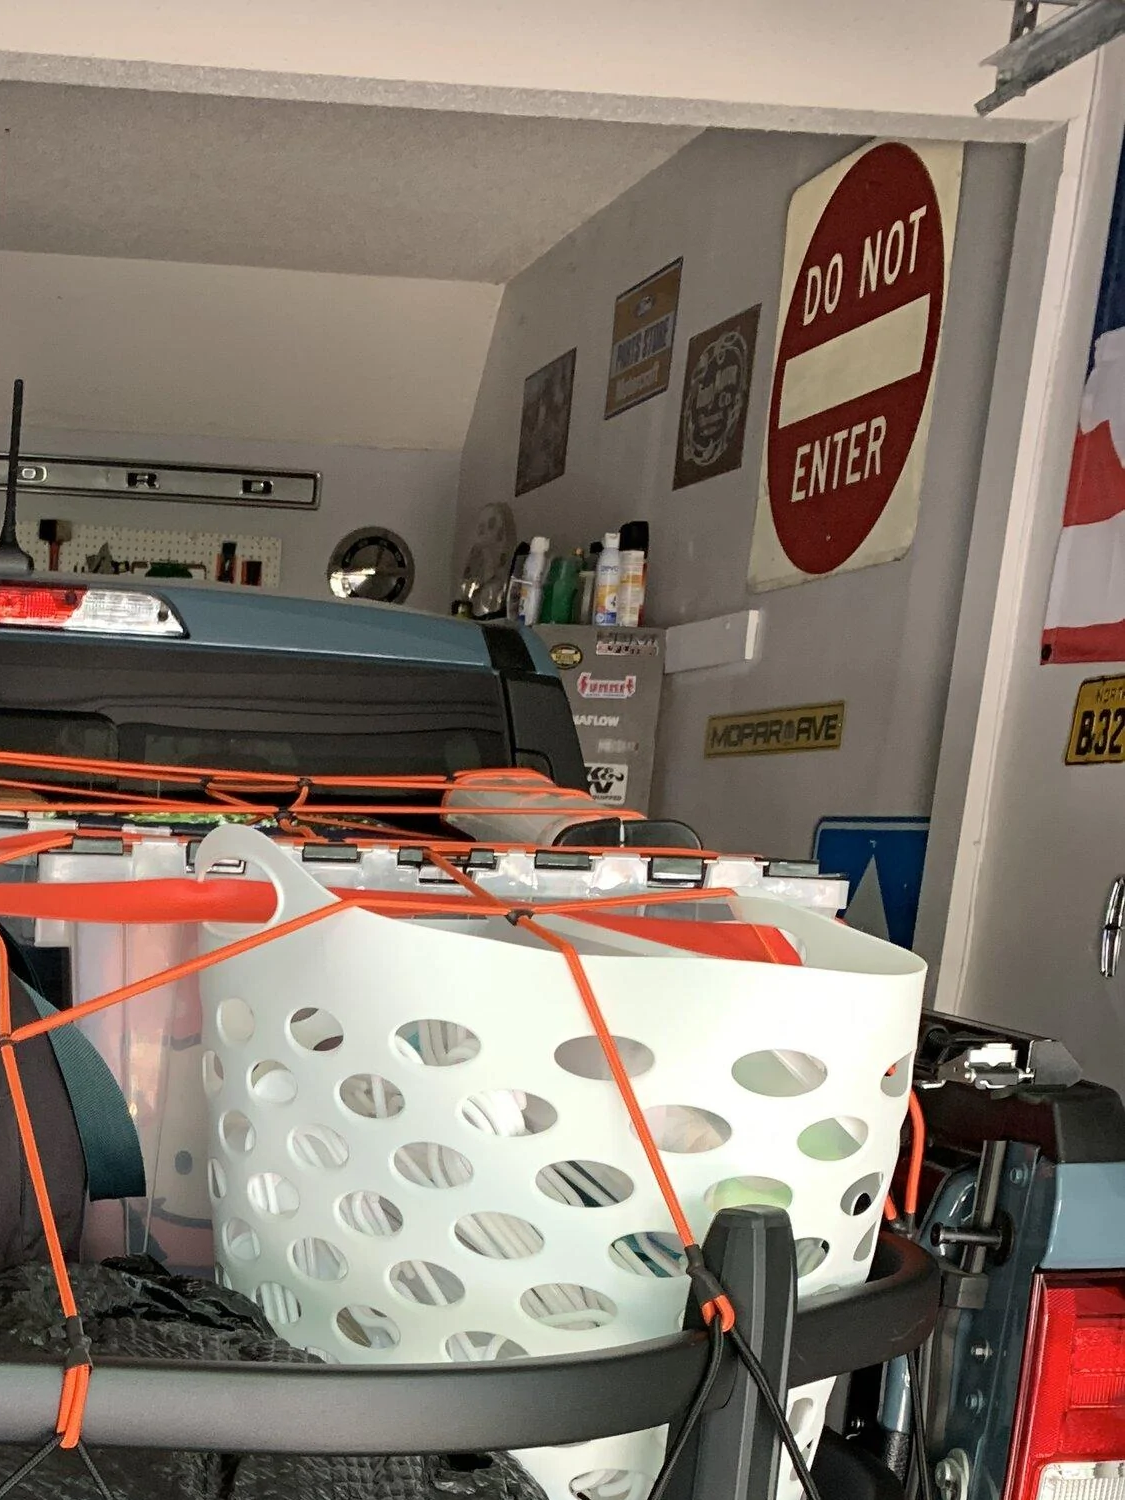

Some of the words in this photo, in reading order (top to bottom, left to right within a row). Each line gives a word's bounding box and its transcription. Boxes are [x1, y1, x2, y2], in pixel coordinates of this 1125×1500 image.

[803, 252, 843, 326] DO
[859, 205, 927, 298] NOT
[791, 415, 886, 503] ENTER
[1096, 686, 1125, 704] NORT
[796, 714, 838, 741] AVE
